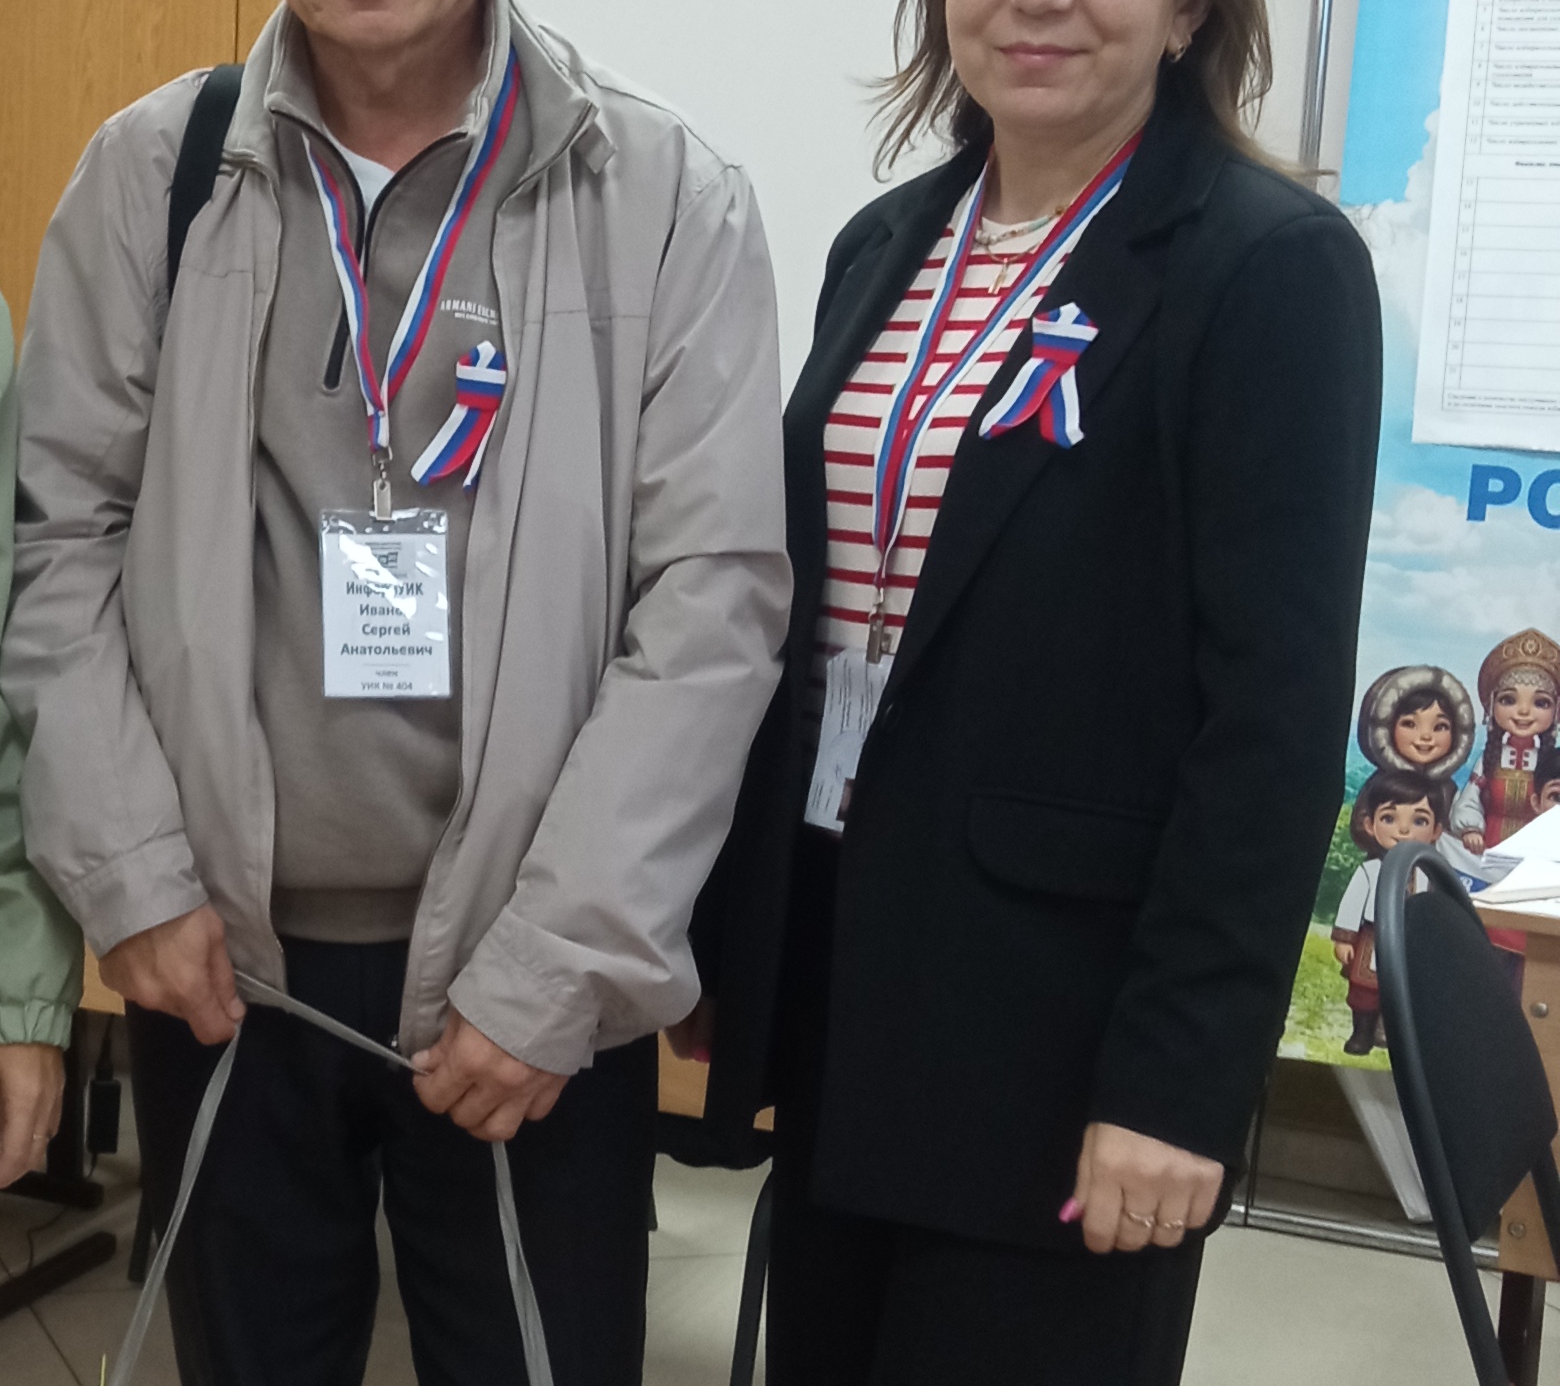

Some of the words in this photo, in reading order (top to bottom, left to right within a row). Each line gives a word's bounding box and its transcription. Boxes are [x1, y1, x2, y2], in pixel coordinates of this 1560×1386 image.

[361, 622, 411, 638] Сергей
[340, 643, 433, 656] Анатольевич
[361, 681, 381, 691] УИК
